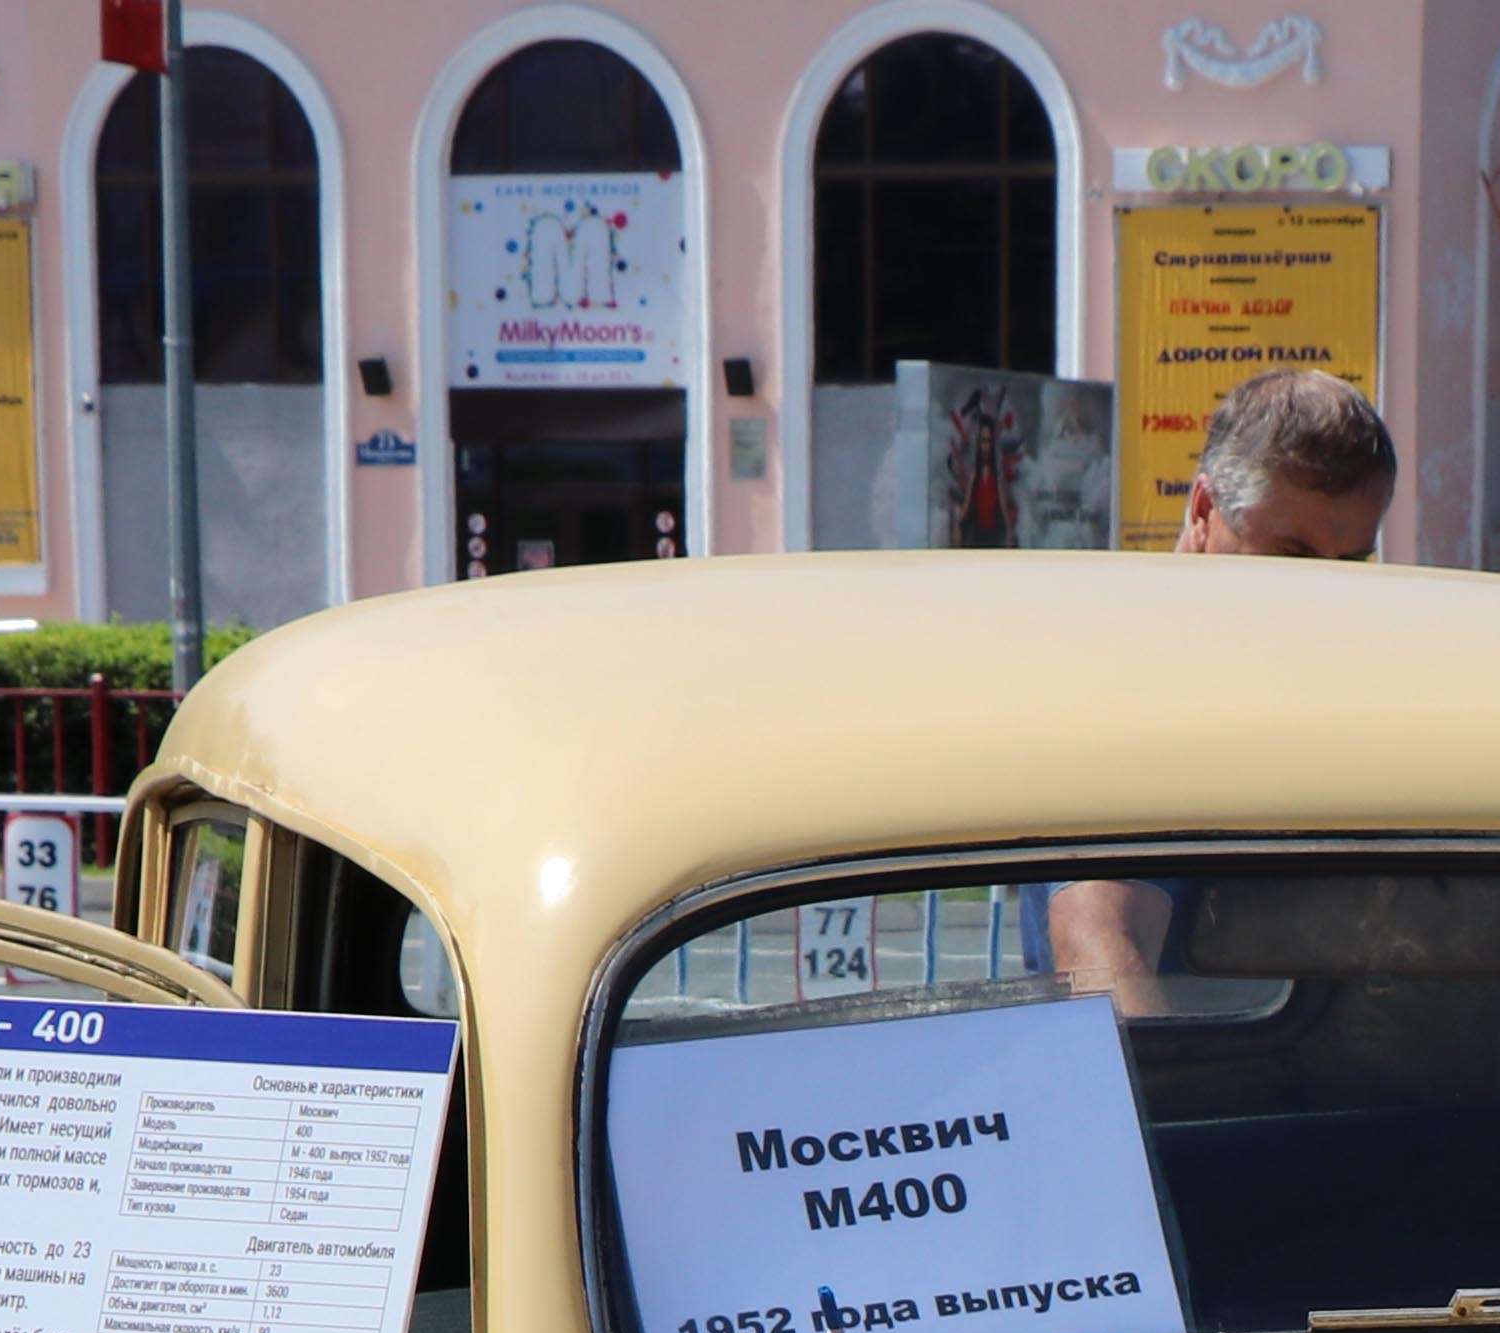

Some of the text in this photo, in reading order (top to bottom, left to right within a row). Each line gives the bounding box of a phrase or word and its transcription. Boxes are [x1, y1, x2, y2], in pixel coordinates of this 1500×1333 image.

[1147, 142, 1347, 193] СКОРО
[1153, 250, 1332, 268] Стриптизёрши
[1157, 345, 1332, 364] ДОРОГОЙ ПАПА
[18, 839, 58, 868] 33
[18, 885, 59, 911] 76
[814, 906, 859, 936] 77
[803, 946, 869, 980] 124
[32, 1009, 104, 1044] 400
[26, 1067, 123, 1090] производили
[251, 1073, 425, 1101] Основные характеристики
[45, 1095, 118, 1114] довольно
[48, 1120, 113, 1143] несущий
[735, 1110, 1011, 1174] Москвич
[8, 1143, 62, 1163] полной
[62, 1148, 108, 1166] массе
[15, 1172, 85, 1193] тормозов
[802, 1171, 968, 1231] М400
[243, 1234, 396, 1260] Двигатель автомобиля
[934, 1269, 1142, 1319] выпуска
